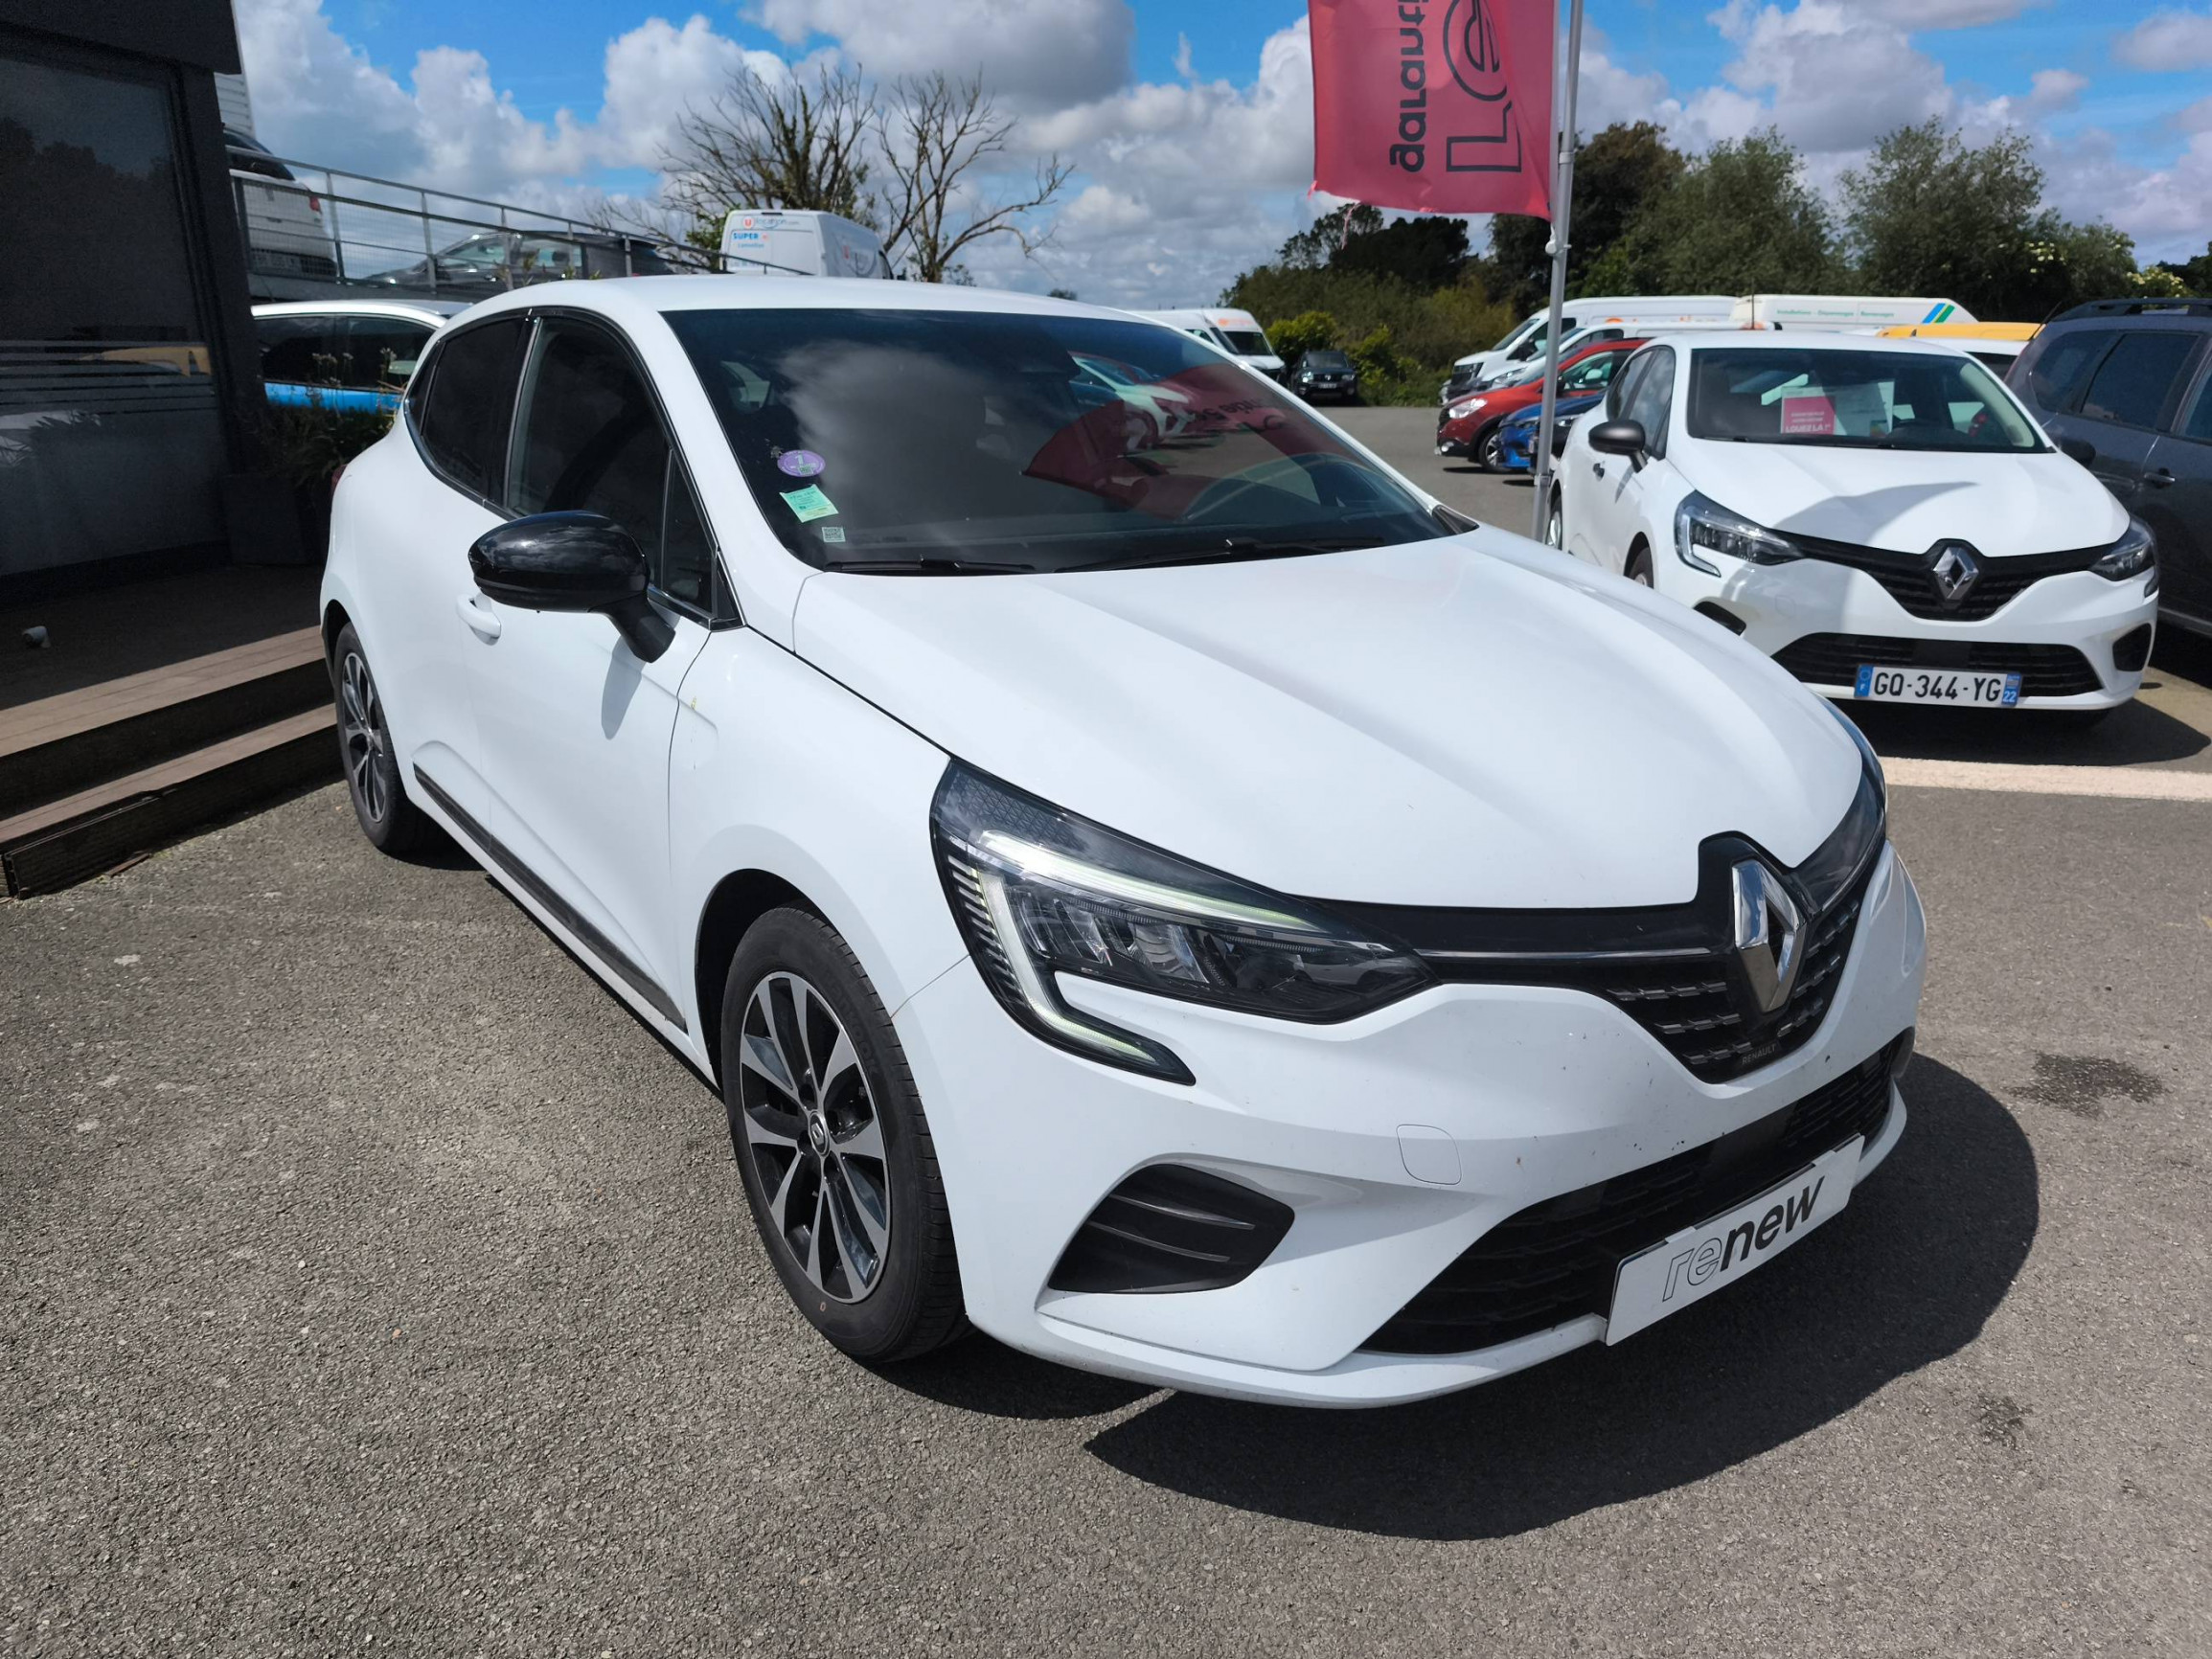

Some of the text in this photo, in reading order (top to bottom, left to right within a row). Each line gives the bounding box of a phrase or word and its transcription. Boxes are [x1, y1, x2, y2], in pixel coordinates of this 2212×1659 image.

[1874, 671, 2001, 702] GQ-344-YG
[2002, 691, 2016, 703] 22
[1742, 1044, 1776, 1064] RENAULT
[1662, 1175, 1825, 1303] renew
